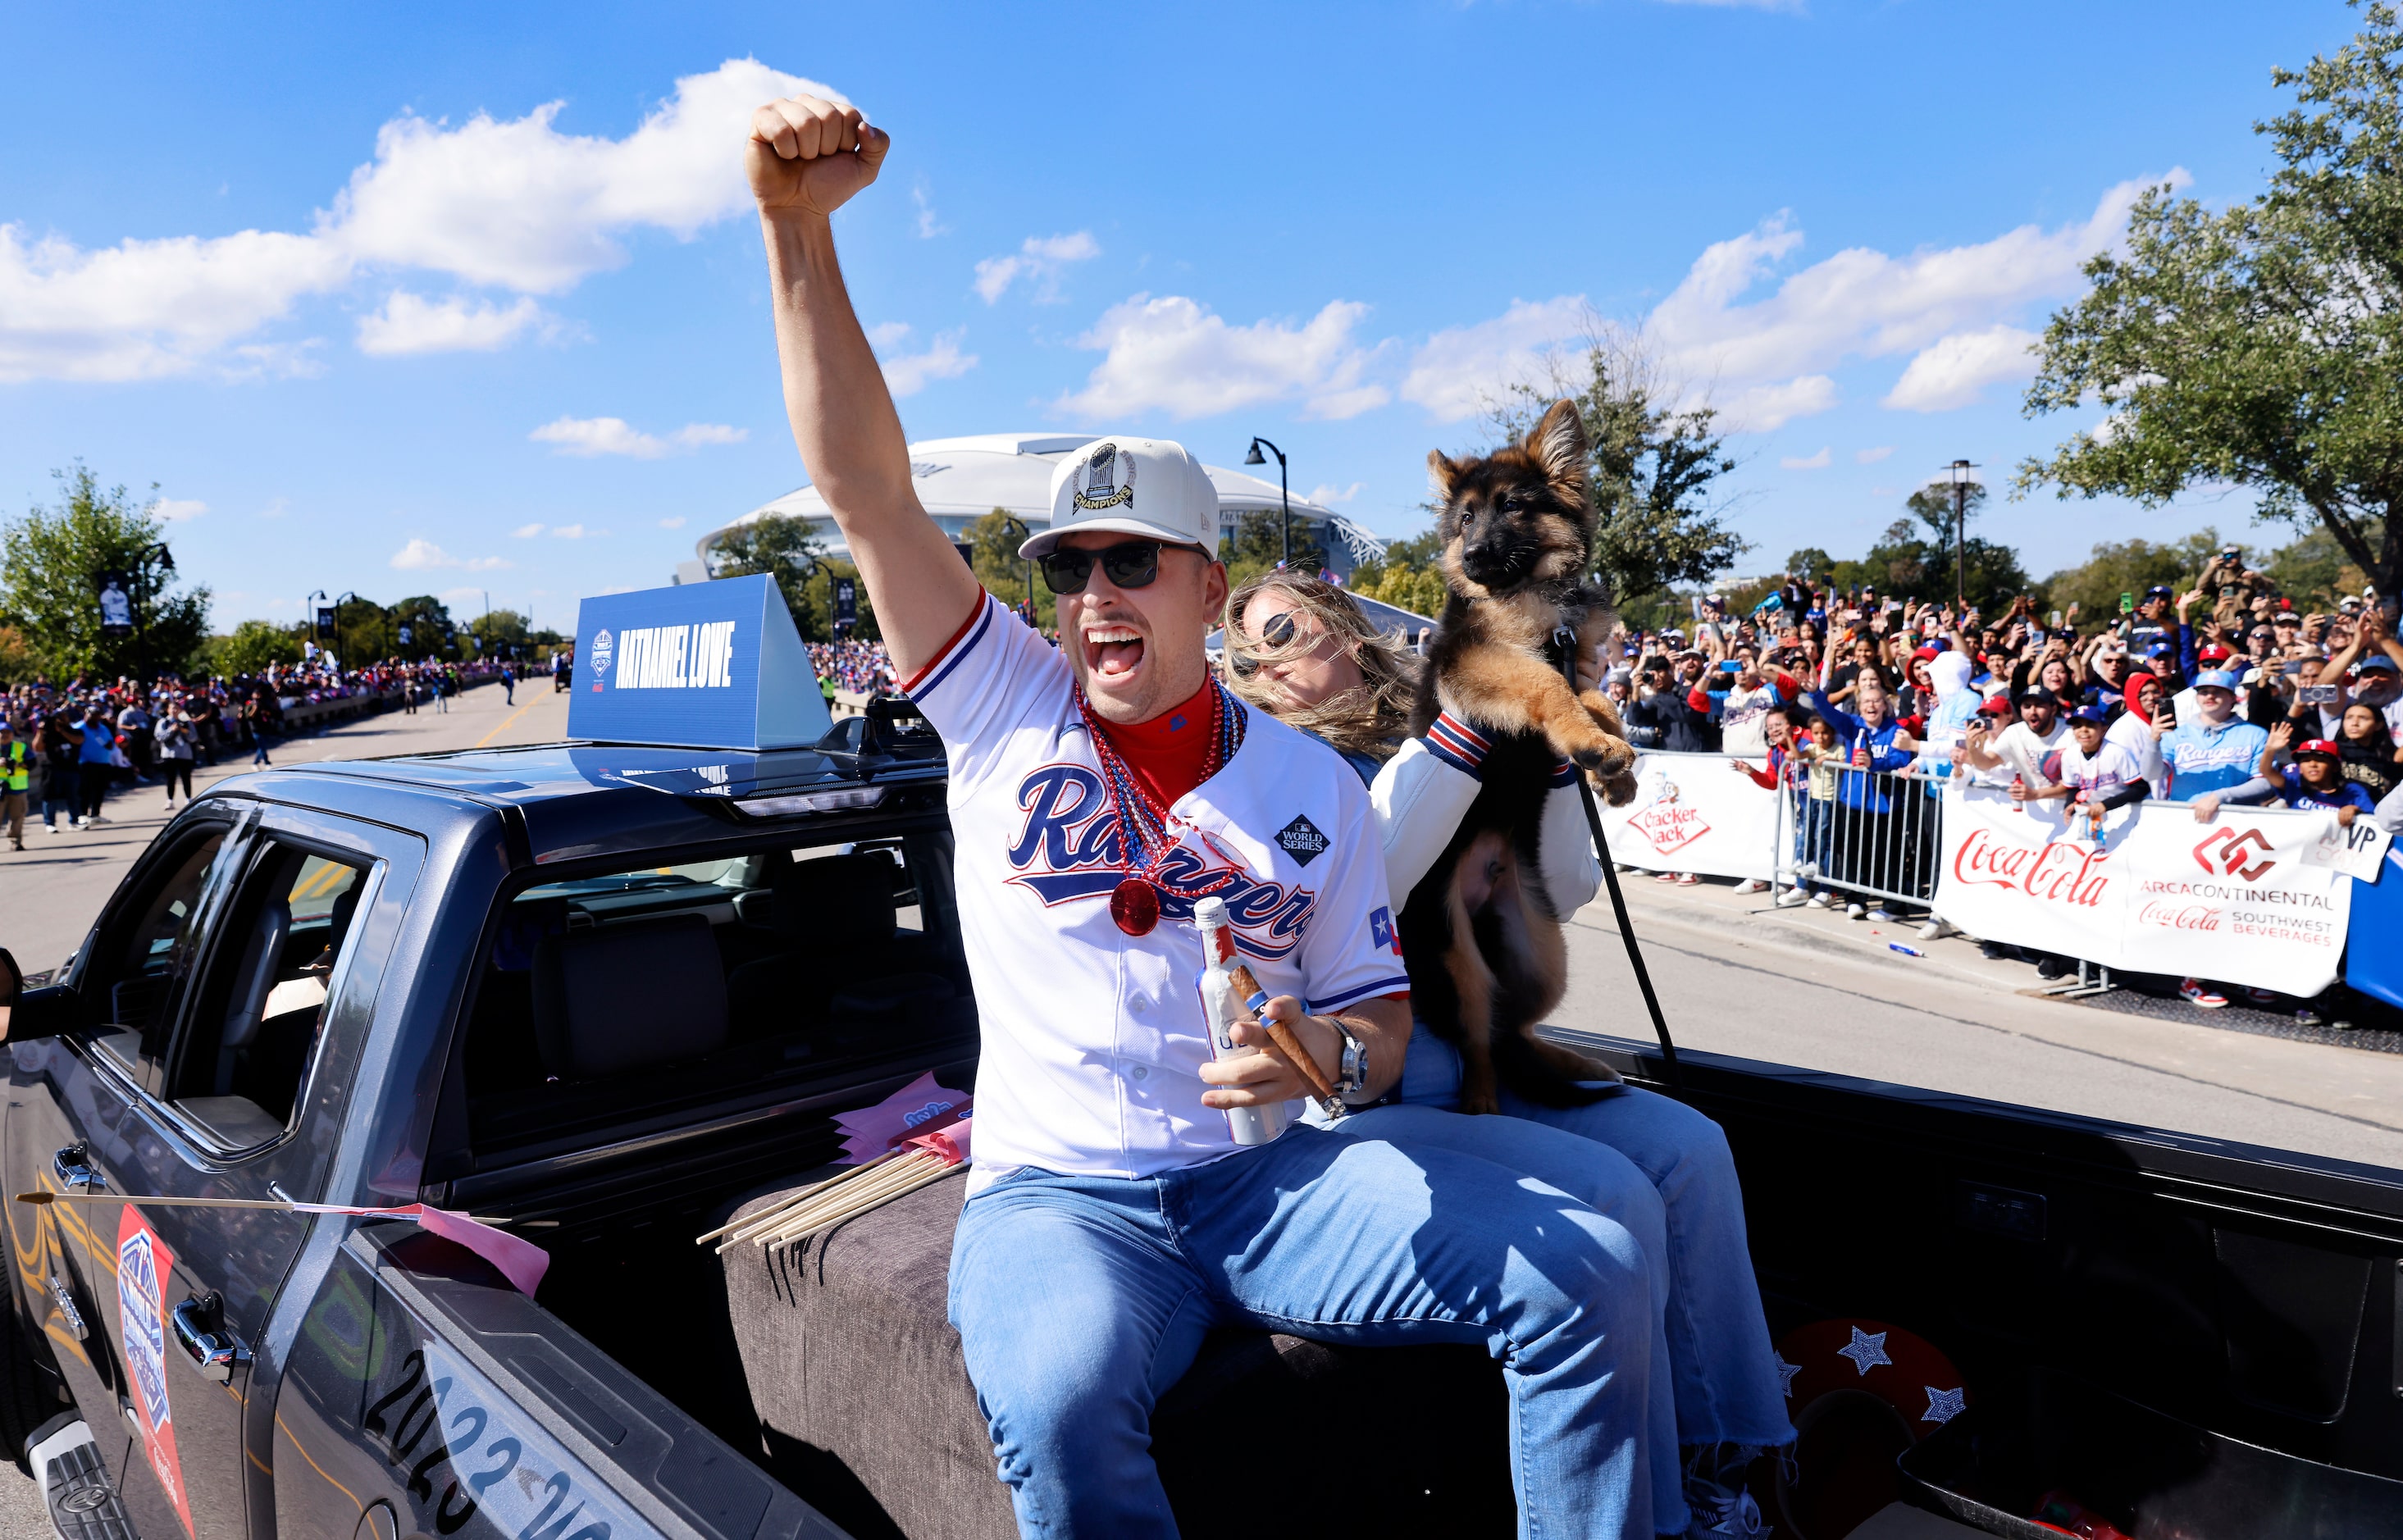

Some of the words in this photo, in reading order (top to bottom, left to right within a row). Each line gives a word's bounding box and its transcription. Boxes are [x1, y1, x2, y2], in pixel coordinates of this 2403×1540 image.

[1075, 486, 1132, 509] CHAMPIONS
[615, 625, 690, 689] NATHANIEL
[688, 621, 736, 689] LOWE
[2173, 742, 2253, 768] Rangers
[1644, 808, 1697, 828] Cracker
[1282, 831, 1323, 842] WORLD
[1283, 839, 1324, 852] SERIES
[2232, 911, 2332, 933] SOUTHWEST
[2233, 923, 2332, 947] BEVERAGES
[127, 1275, 152, 1334] WORLD
